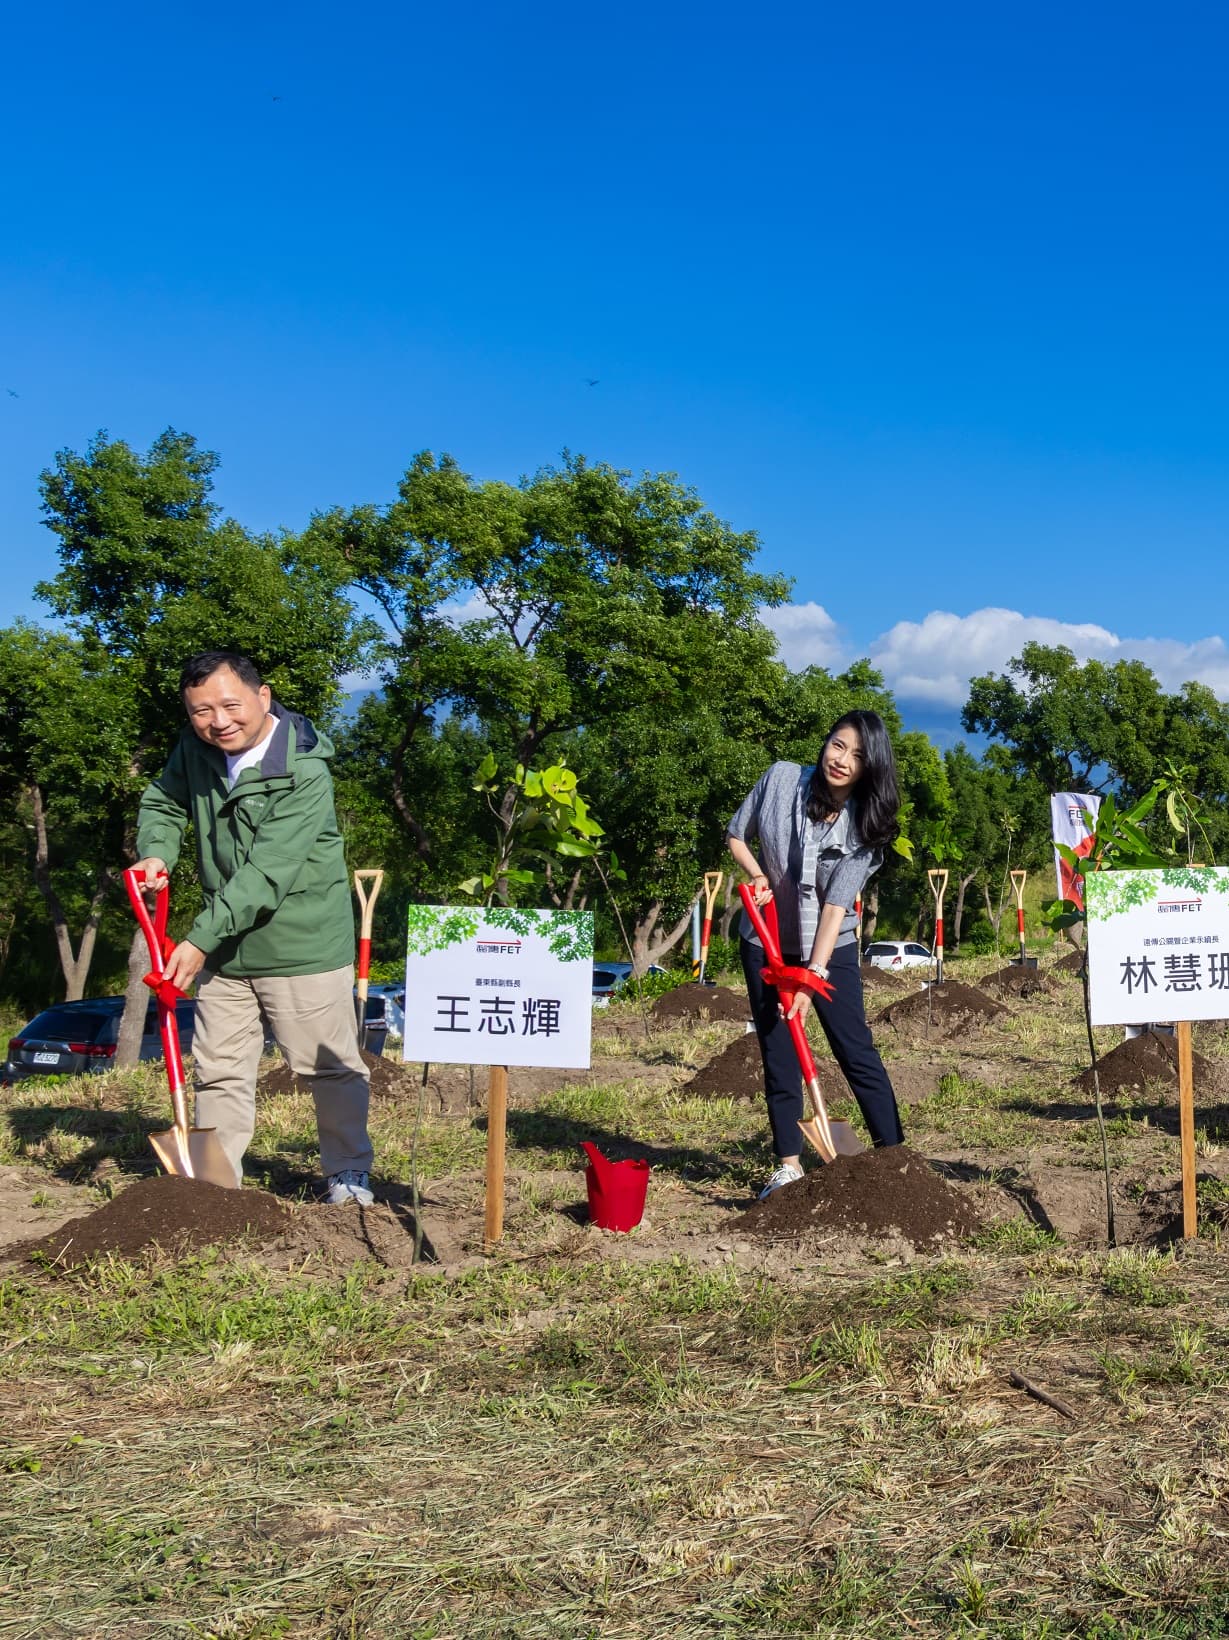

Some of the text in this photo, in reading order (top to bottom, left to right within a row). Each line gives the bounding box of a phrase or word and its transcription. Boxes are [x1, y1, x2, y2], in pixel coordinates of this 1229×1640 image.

[1181, 904, 1202, 912] FET
[500, 945, 522, 954] FET
[433, 995, 561, 1037] 王志輝
